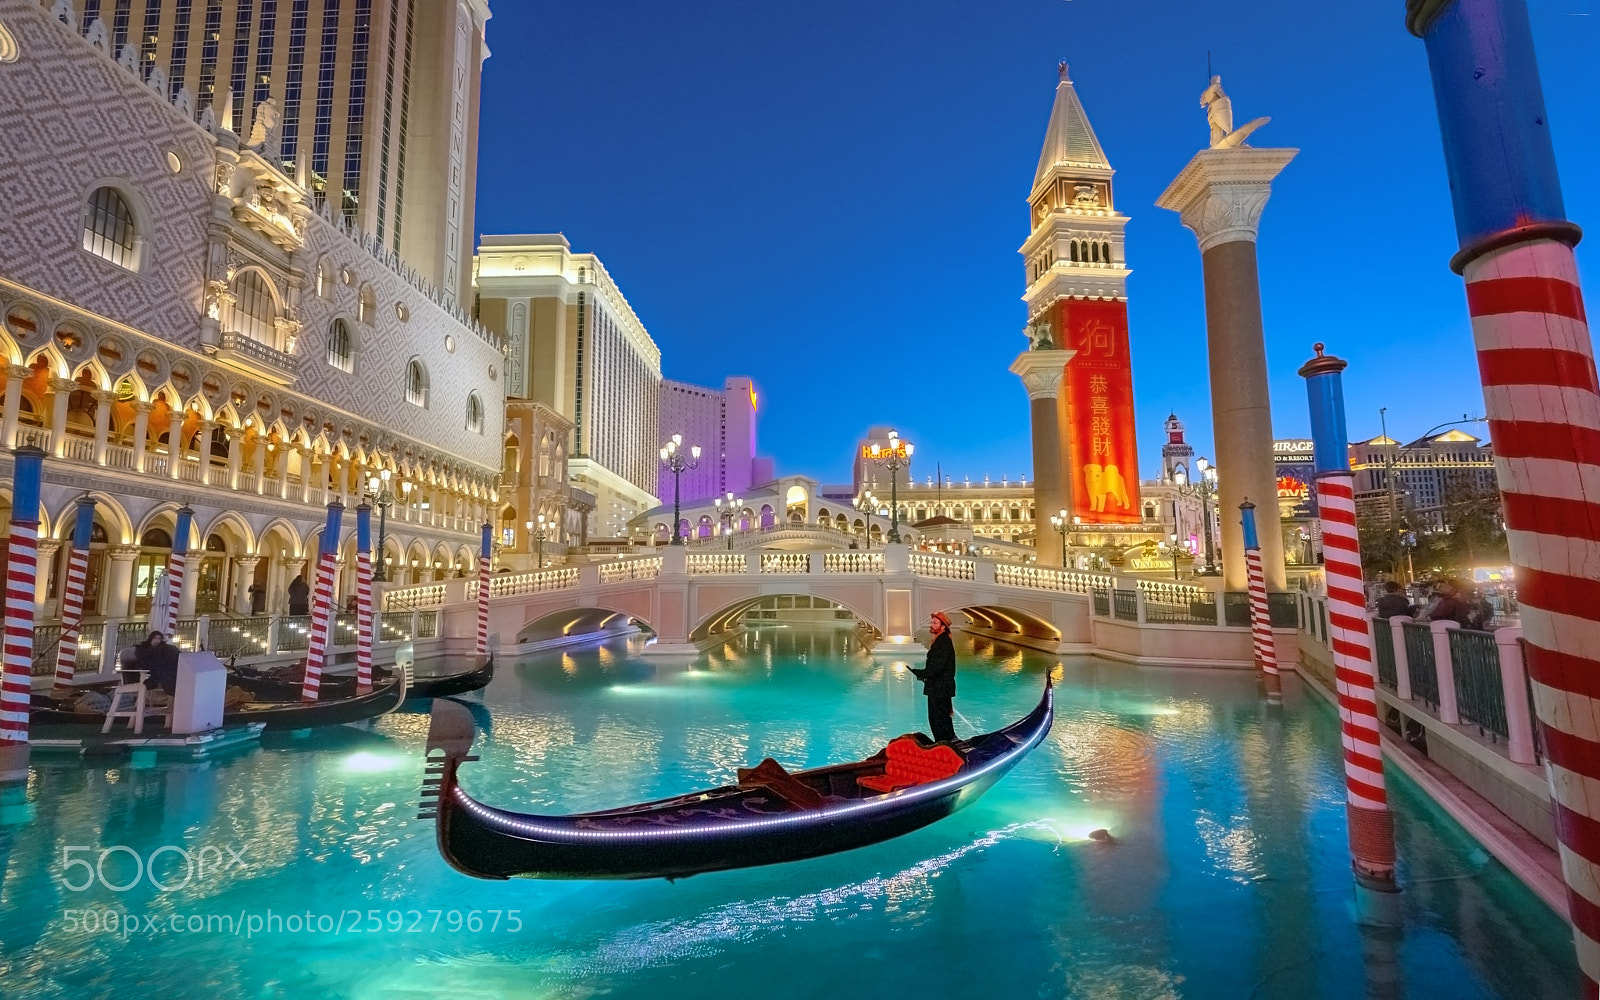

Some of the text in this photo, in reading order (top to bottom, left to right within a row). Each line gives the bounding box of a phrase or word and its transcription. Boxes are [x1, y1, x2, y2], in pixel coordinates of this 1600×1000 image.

[446, 68, 466, 304] VENETIA
[1079, 319, 1115, 357] 狗
[1090, 374, 1111, 457] 恭喜發財
[1277, 488, 1310, 501] OVE
